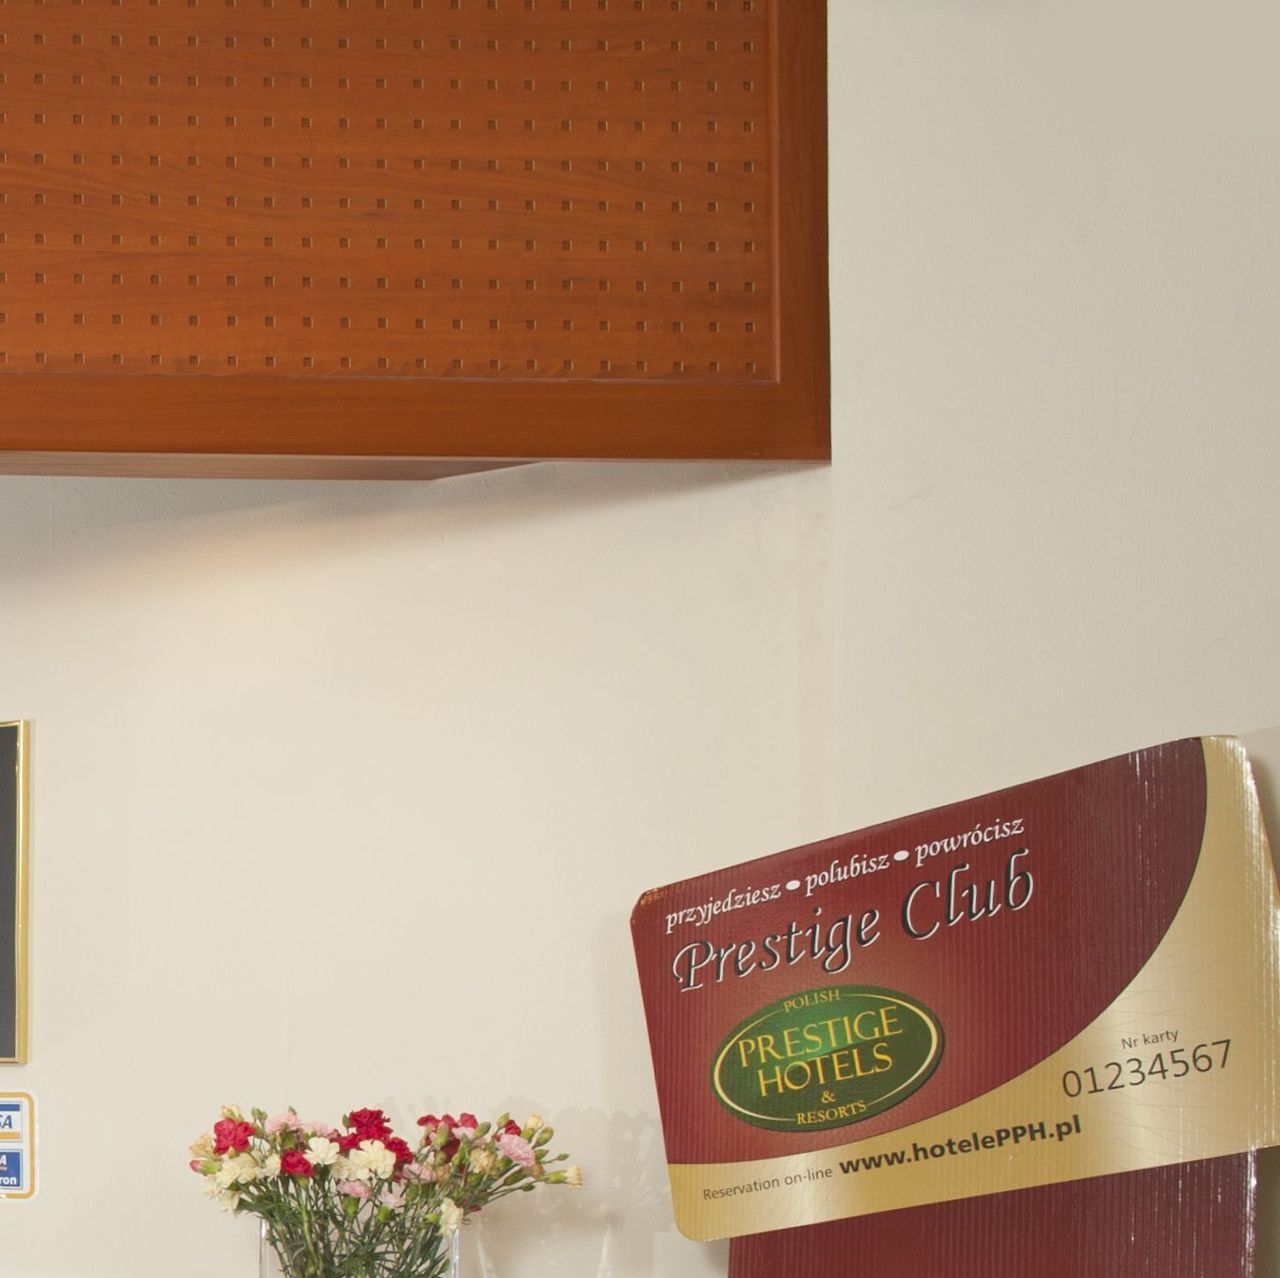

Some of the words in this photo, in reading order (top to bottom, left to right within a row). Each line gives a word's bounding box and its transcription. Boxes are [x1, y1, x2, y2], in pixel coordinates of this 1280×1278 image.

[665, 876, 783, 935] przyjedziesz
[804, 850, 891, 898] polubisz
[914, 814, 1026, 867] powrócisz
[671, 905, 882, 993] Prestige
[900, 848, 1037, 942] Club
[782, 988, 842, 1013] POLISH
[738, 1005, 906, 1071] PRESTIGE
[1121, 1034, 1140, 1051] Nr
[1142, 1027, 1181, 1049] karty
[756, 1043, 895, 1098] HOTELS
[820, 1089, 837, 1104] &
[1061, 1038, 1233, 1100] 01234567
[795, 1100, 869, 1126] RESORTS
[702, 1175, 781, 1202] Reservation
[783, 1165, 835, 1187] on-line
[838, 1114, 1083, 1177] www.hotelePPH.pl
